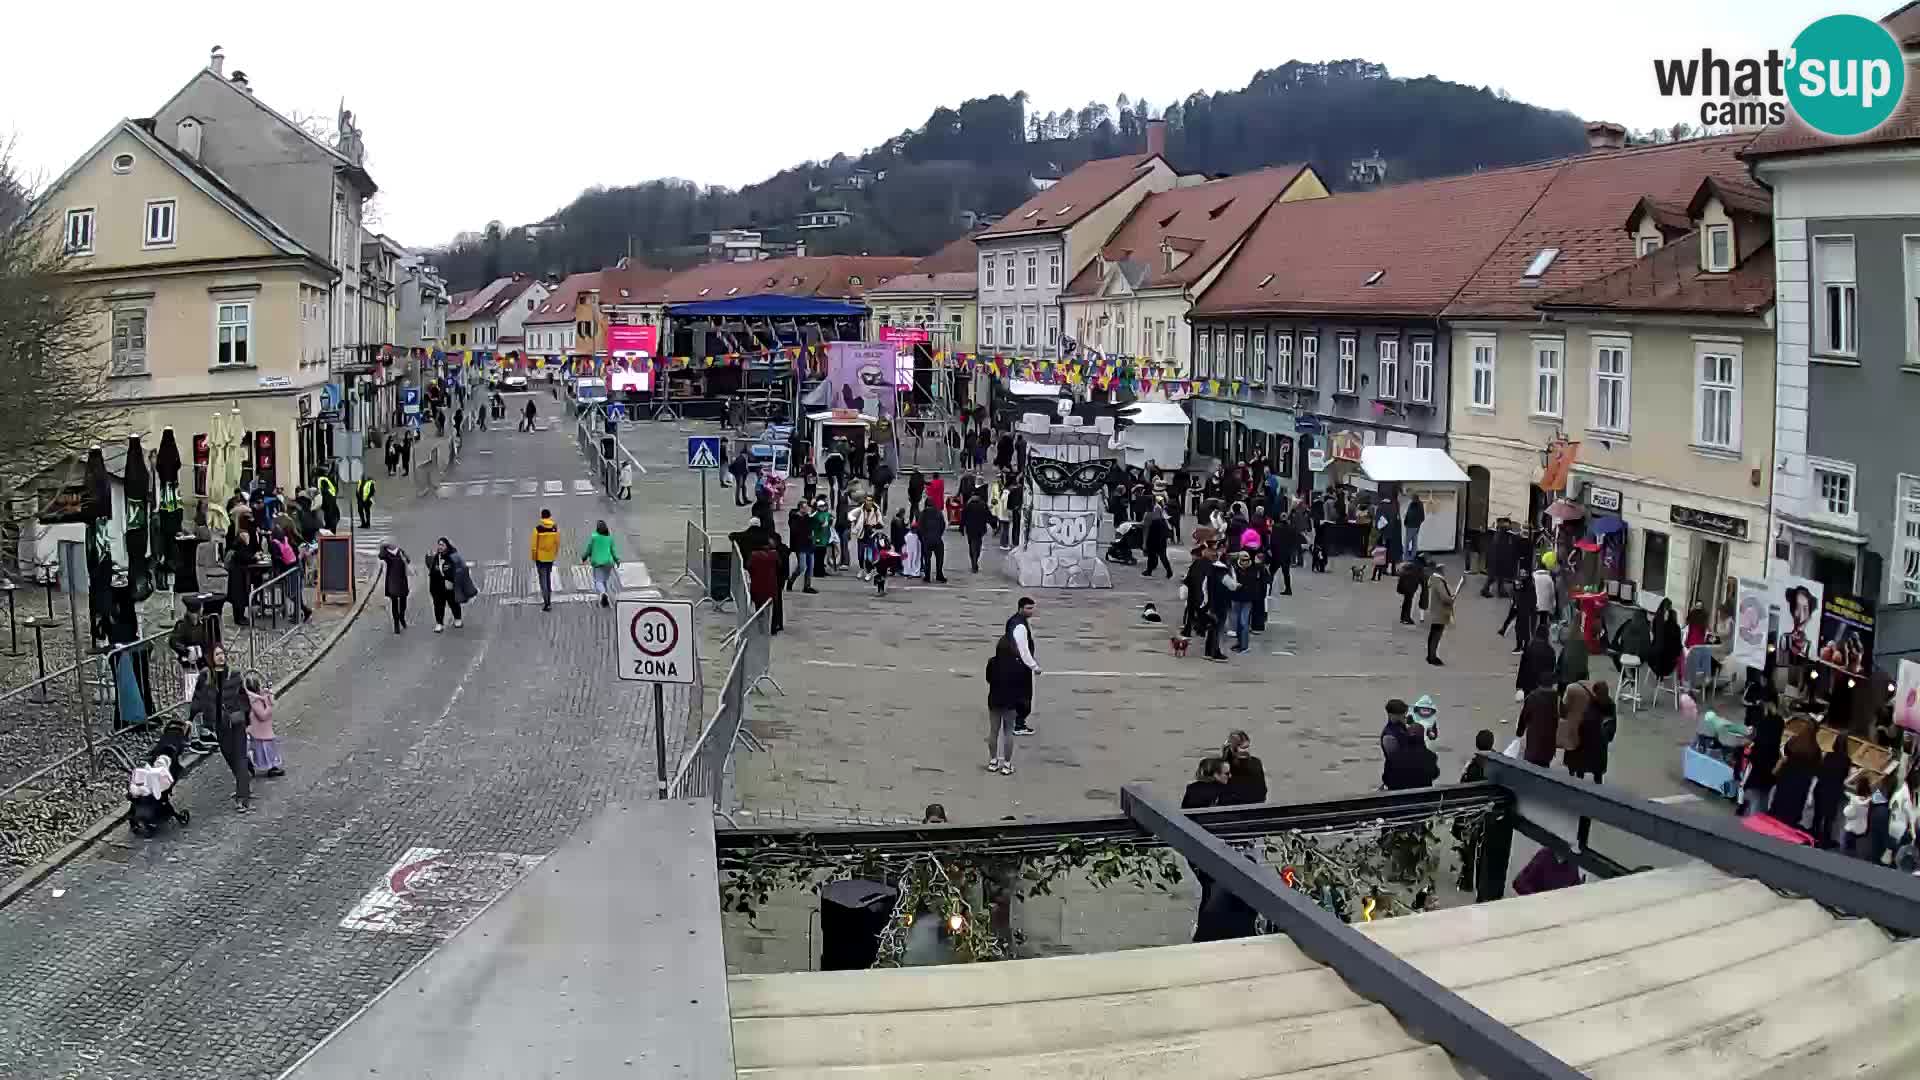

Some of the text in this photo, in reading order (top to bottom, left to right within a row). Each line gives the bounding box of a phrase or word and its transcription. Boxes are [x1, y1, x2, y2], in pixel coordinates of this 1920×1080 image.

[407, 391, 415, 403] P
[1048, 516, 1087, 545] 200
[643, 622, 667, 643] 30
[633, 660, 678, 677] ZONA
